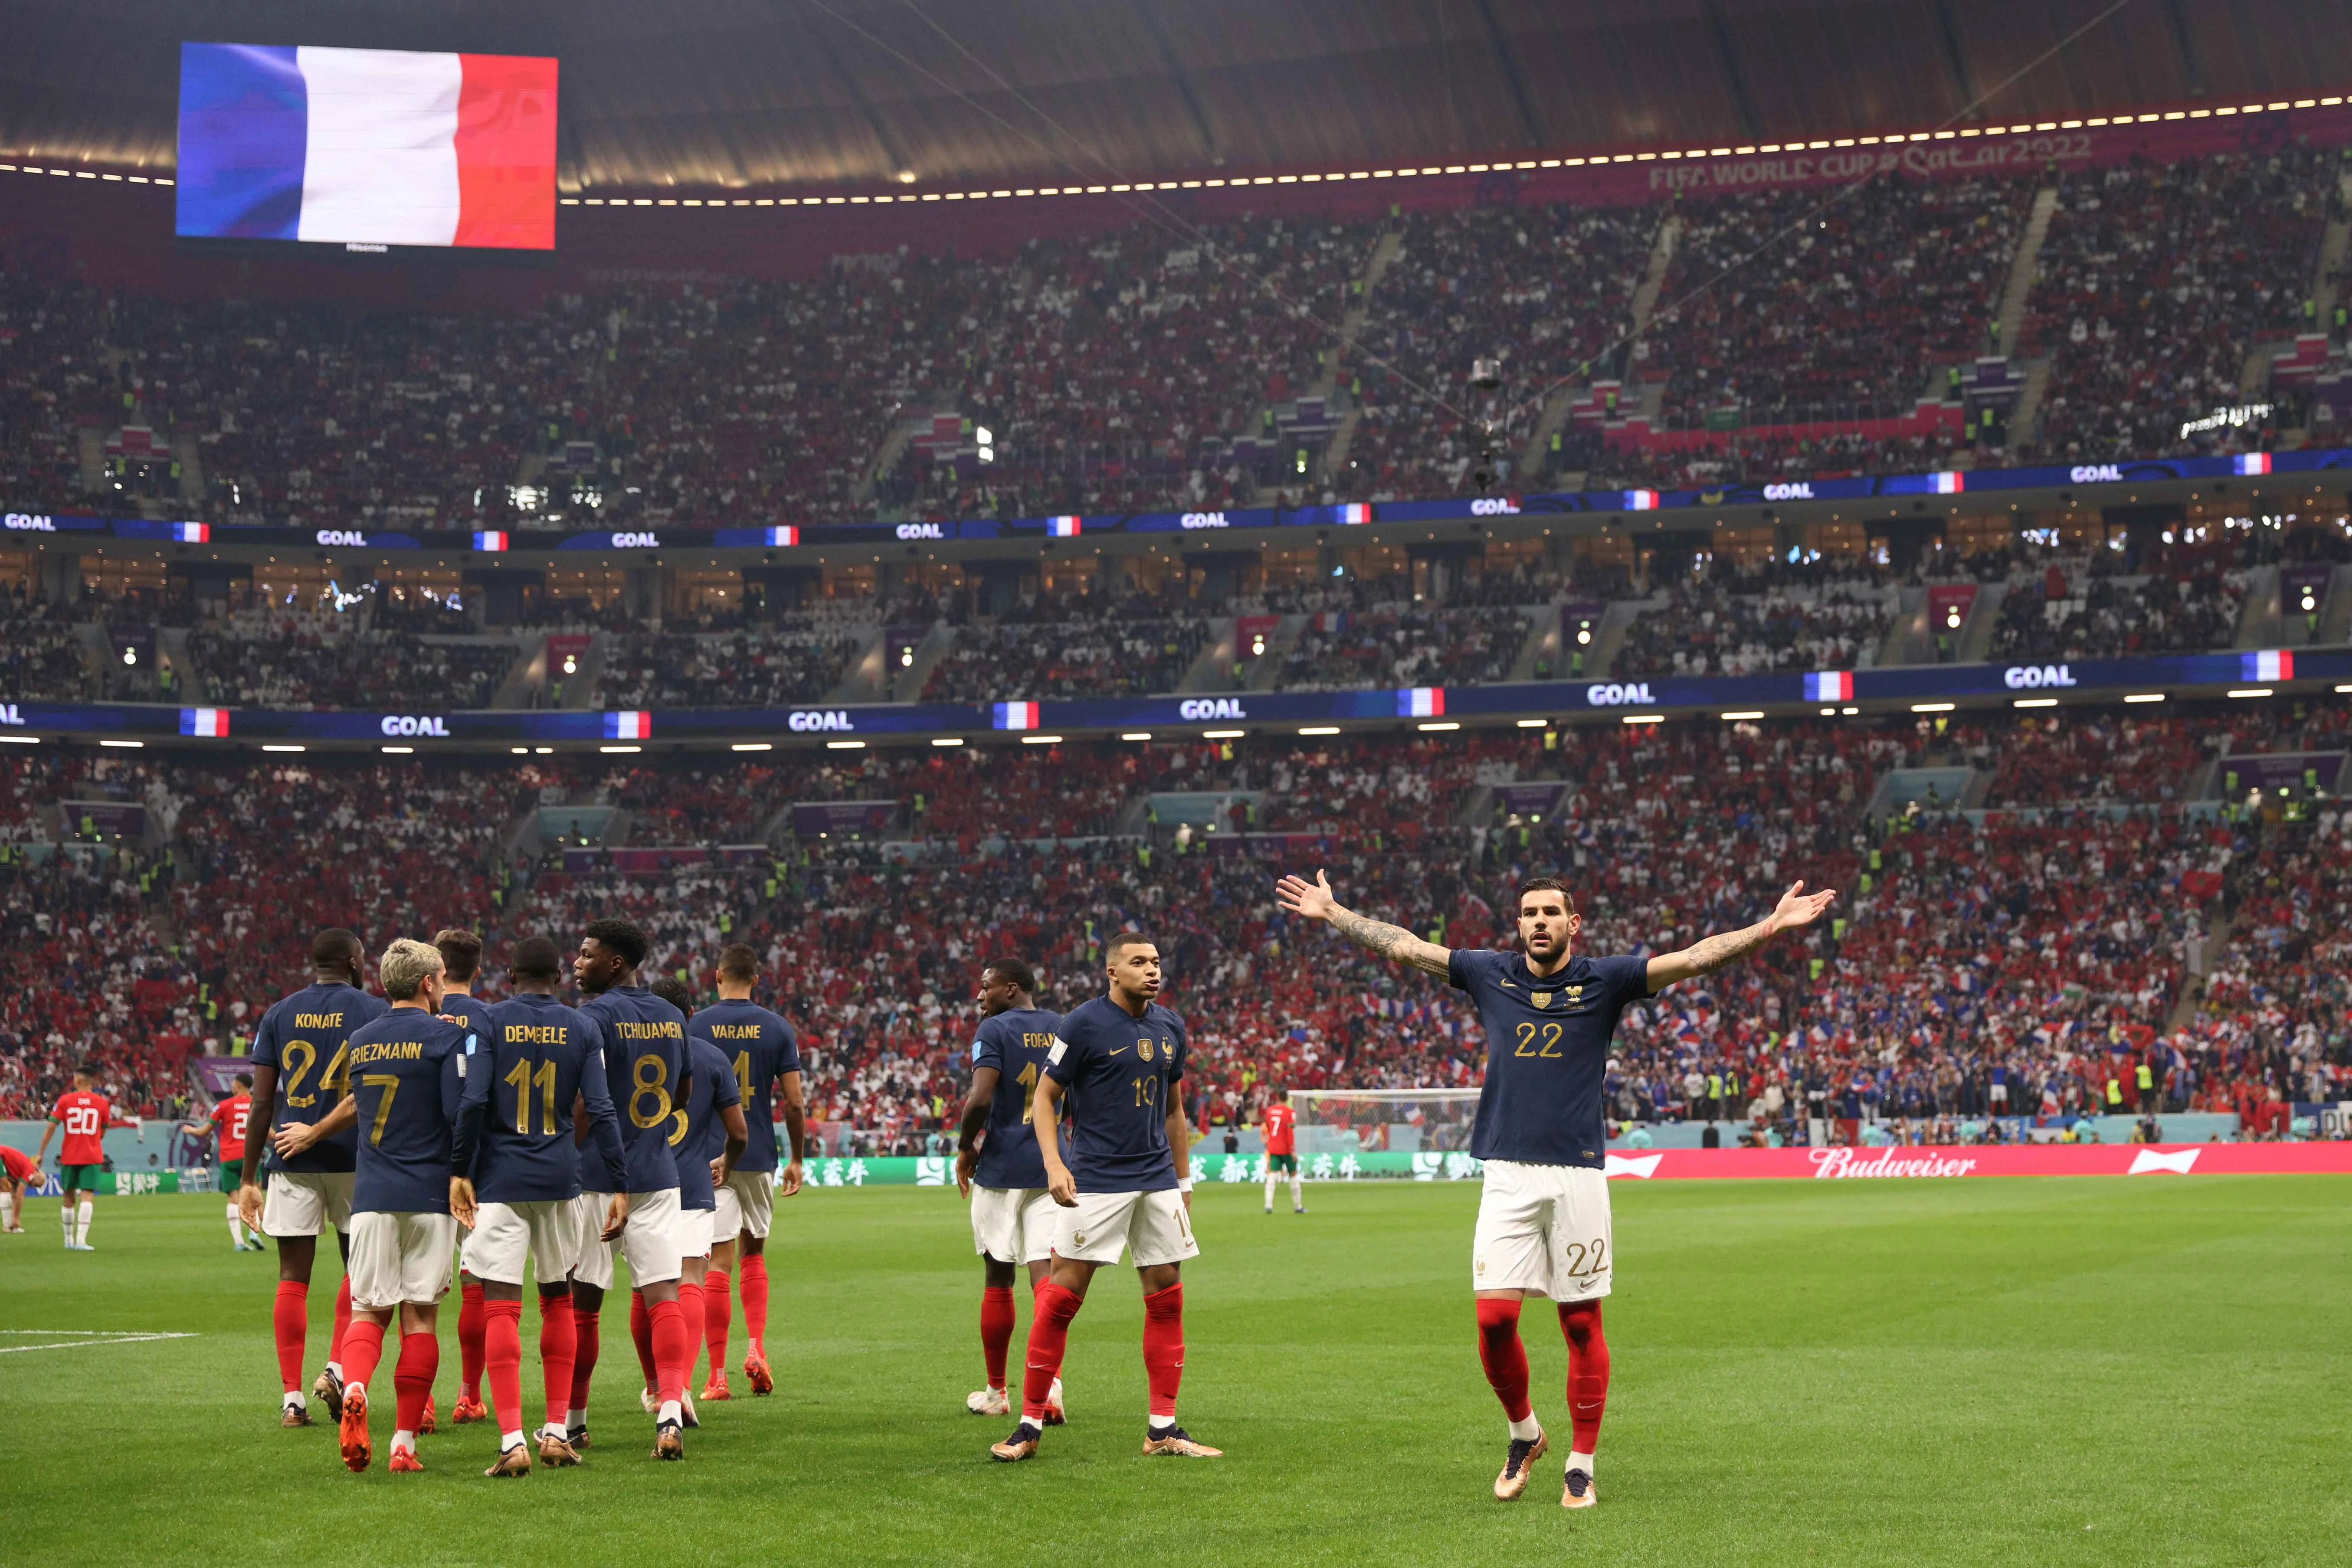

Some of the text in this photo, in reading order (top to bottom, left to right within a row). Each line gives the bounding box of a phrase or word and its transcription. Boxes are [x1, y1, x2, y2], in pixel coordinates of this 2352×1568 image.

[1649, 164, 1708, 190] FIFA
[1710, 157, 1814, 187] WORLD
[1819, 151, 1875, 177] CUP
[2070, 464, 2123, 483] GOAL
[1763, 483, 1814, 500] GOAL
[4, 513, 56, 531] GOAL
[896, 523, 943, 540] GOAL
[1181, 512, 1229, 529] GOAL
[317, 530, 367, 546] GOAL
[612, 532, 660, 548] GOAL
[2004, 665, 2077, 688] GOAL
[1587, 683, 1656, 705] GOAL
[1180, 698, 1246, 720] GOAL
[381, 716, 450, 737] GOAL
[789, 711, 854, 731] GOAL
[295, 1012, 344, 1029] KONATE
[505, 1025, 568, 1044] DEMBELE
[711, 1025, 761, 1039] VARANE
[1514, 1022, 1563, 1057] 22
[350, 1042, 423, 1067] GRIEZMANN
[282, 1039, 352, 1108] 24
[504, 1057, 557, 1135] 11
[629, 1054, 672, 1128] 8
[1131, 1075, 1158, 1106] 10
[66, 1106, 99, 1136] 20
[362, 1074, 400, 1147] 7
[233, 1112, 249, 1140] 2
[1270, 1116, 1281, 1137] 7
[1808, 1147, 1977, 1178] Budweiser
[1566, 1238, 1608, 1277] 22
